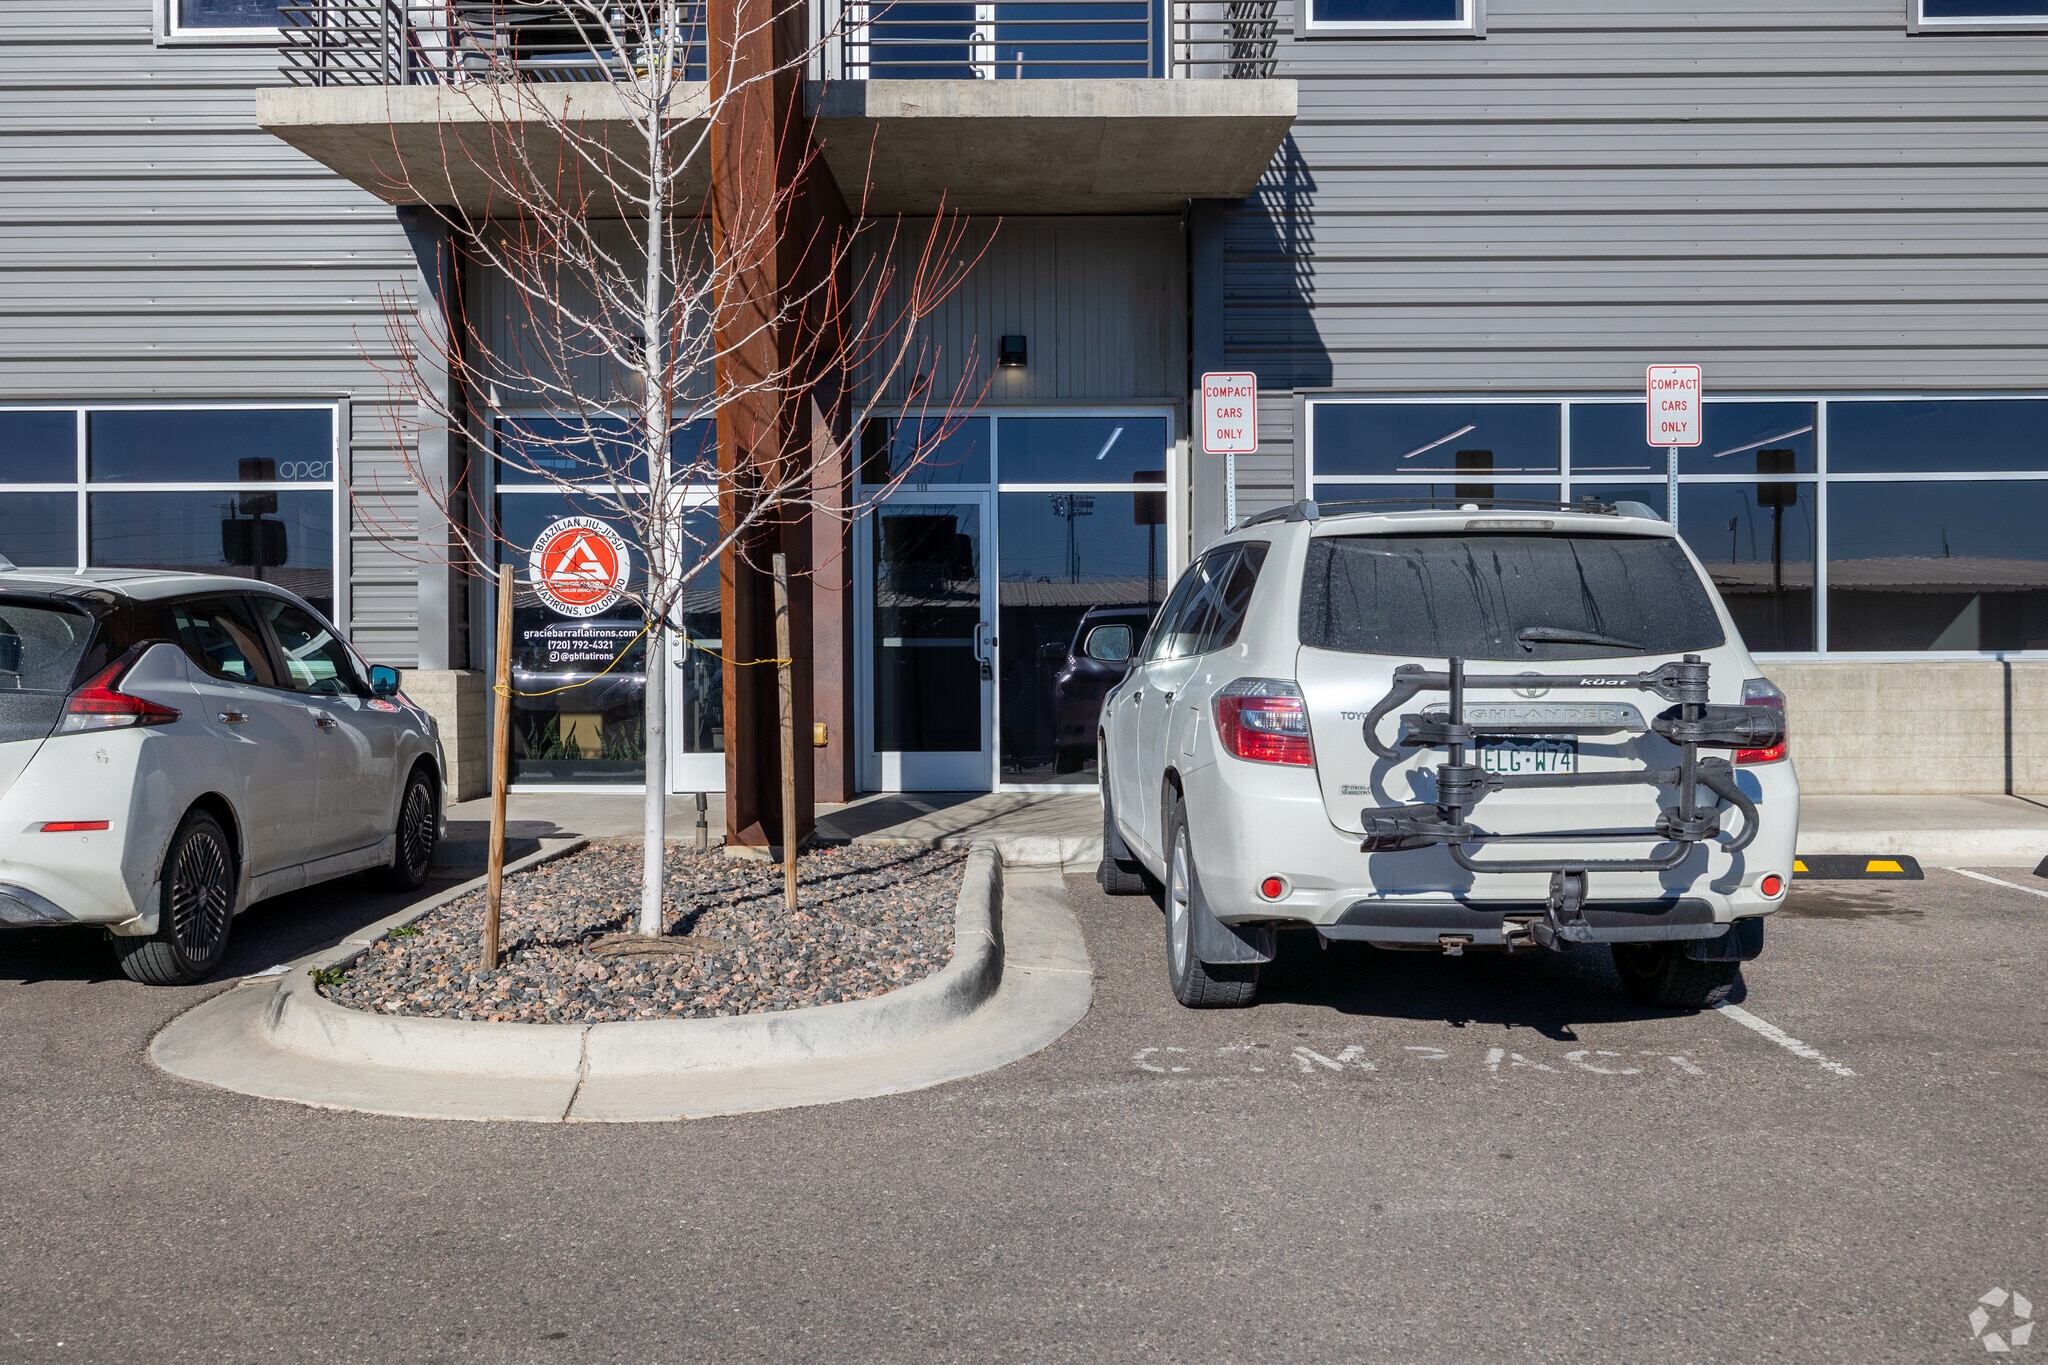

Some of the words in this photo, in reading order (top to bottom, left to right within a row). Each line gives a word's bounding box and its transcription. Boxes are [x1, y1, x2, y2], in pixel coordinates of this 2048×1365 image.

[1650, 379, 1698, 390] COMPACT
[1206, 386, 1252, 397] COMPACT
[1661, 400, 1687, 411] CARS
[1216, 407, 1243, 419] CARS
[1661, 422, 1688, 432] ONLY
[1216, 428, 1243, 439] ONLY
[535, 518, 581, 551] BRAZILIAN
[583, 519, 625, 551] JIU-JITSU
[523, 629, 638, 639] graciebarraflatirons.com
[548, 640, 570, 650] (720)
[572, 640, 613, 649] 792-4321
[560, 652, 614, 661] @gbflatirons
[1340, 711, 1384, 720] TOYO
[1440, 708, 1618, 720] IGHLANDER
